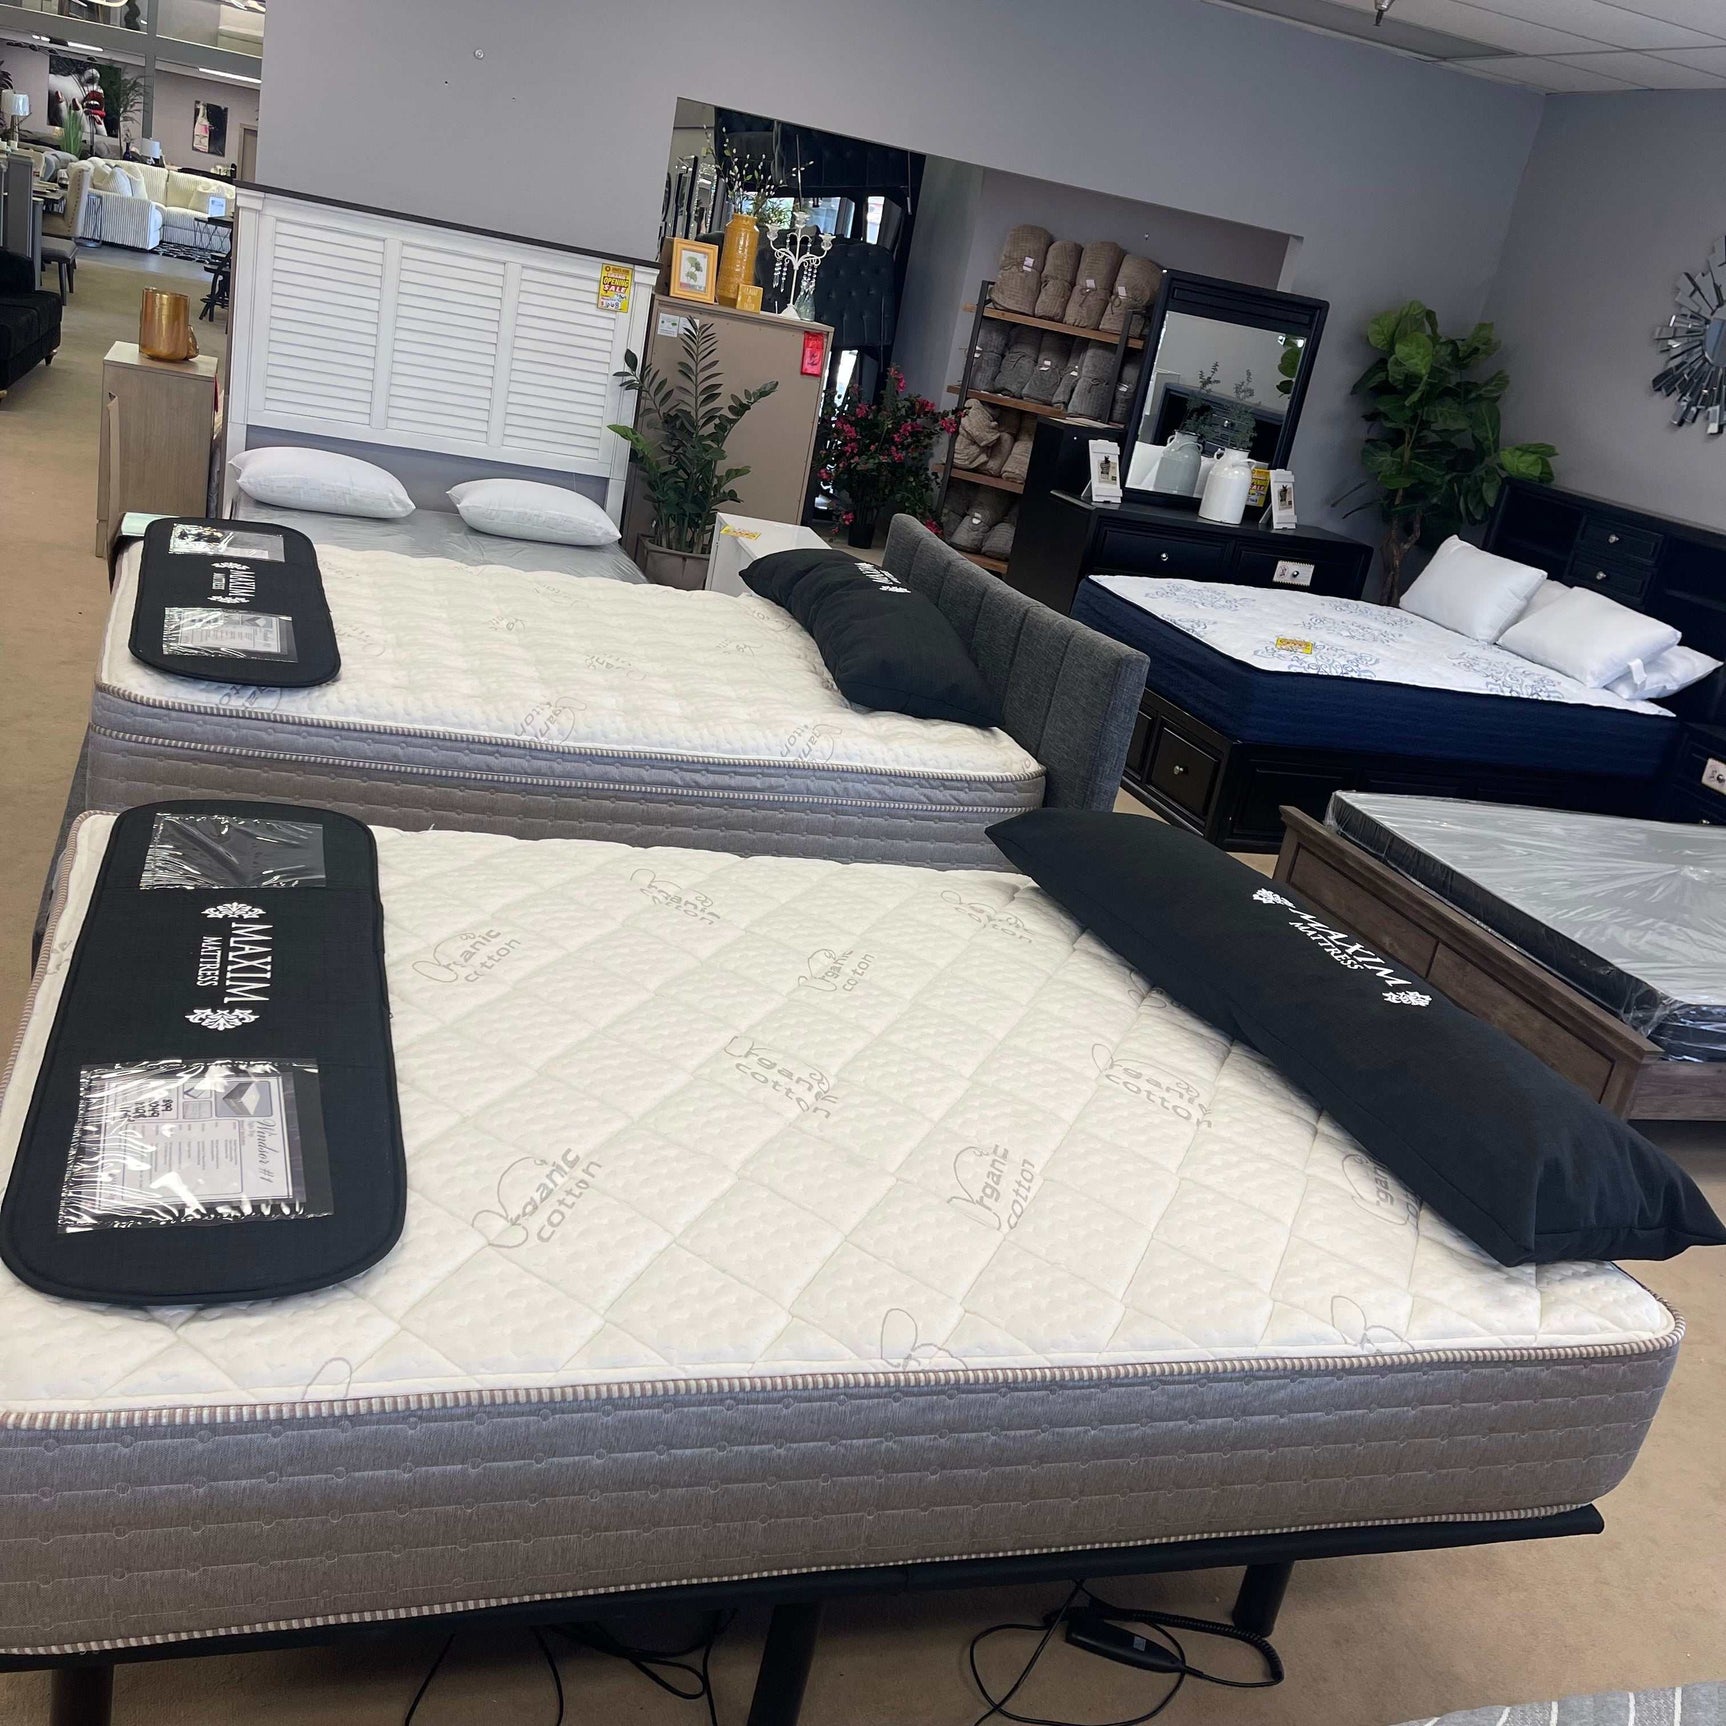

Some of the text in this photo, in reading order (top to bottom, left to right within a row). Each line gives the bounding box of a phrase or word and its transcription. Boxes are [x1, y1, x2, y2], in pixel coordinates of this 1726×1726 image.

[603, 276, 629, 288] OPENING
[603, 284, 627, 293] SALE
[196, 936, 223, 987] MATTRESS
[223, 921, 274, 1004] MAXIM
[412, 929, 502, 983] Oranic
[1288, 921, 1364, 970] MATTRESS
[1288, 907, 1412, 987] MAXIM
[842, 953, 875, 993] coton
[256, 1119, 280, 1165] Windsor
[536, 1160, 603, 1243] cotton
